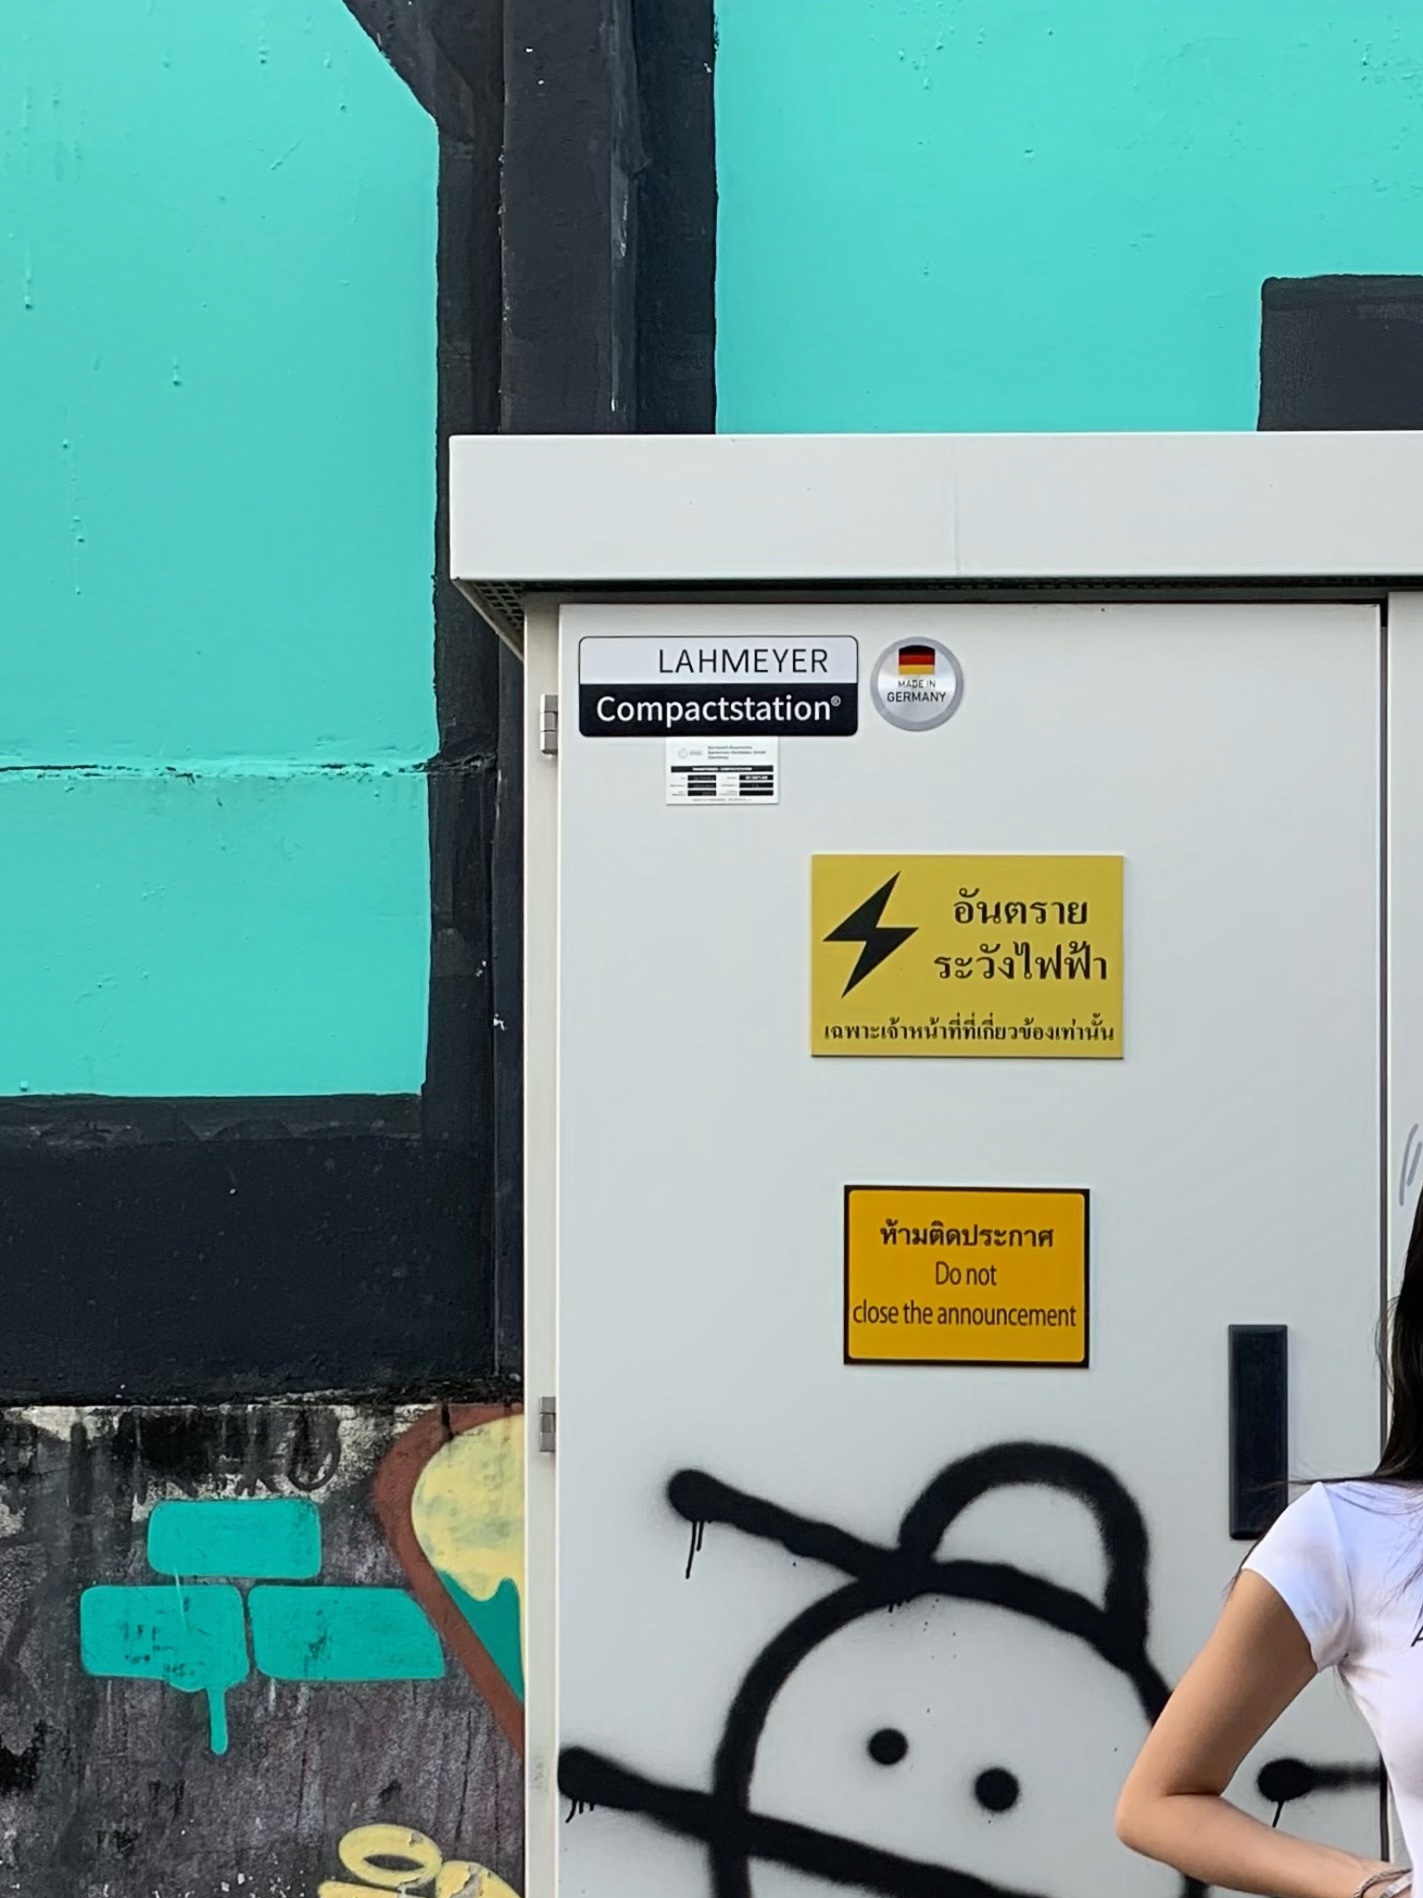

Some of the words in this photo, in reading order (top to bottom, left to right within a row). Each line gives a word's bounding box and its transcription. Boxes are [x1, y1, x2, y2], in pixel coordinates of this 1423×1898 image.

[658, 648, 829, 674] LAHMEYER
[887, 691, 946, 703] GERMANY
[898, 680, 924, 689] MADE
[927, 680, 936, 688] IN
[954, 887, 1089, 925] อันตราย
[934, 941, 1108, 980] ระวังไฟฟ้า
[879, 1218, 1054, 1247] ห้ามติดประกาศ
[935, 1261, 962, 1285] Do
[966, 1265, 997, 1286] not
[852, 1299, 899, 1324] close
[903, 1300, 933, 1325] the
[937, 1305, 1077, 1327] announcement
